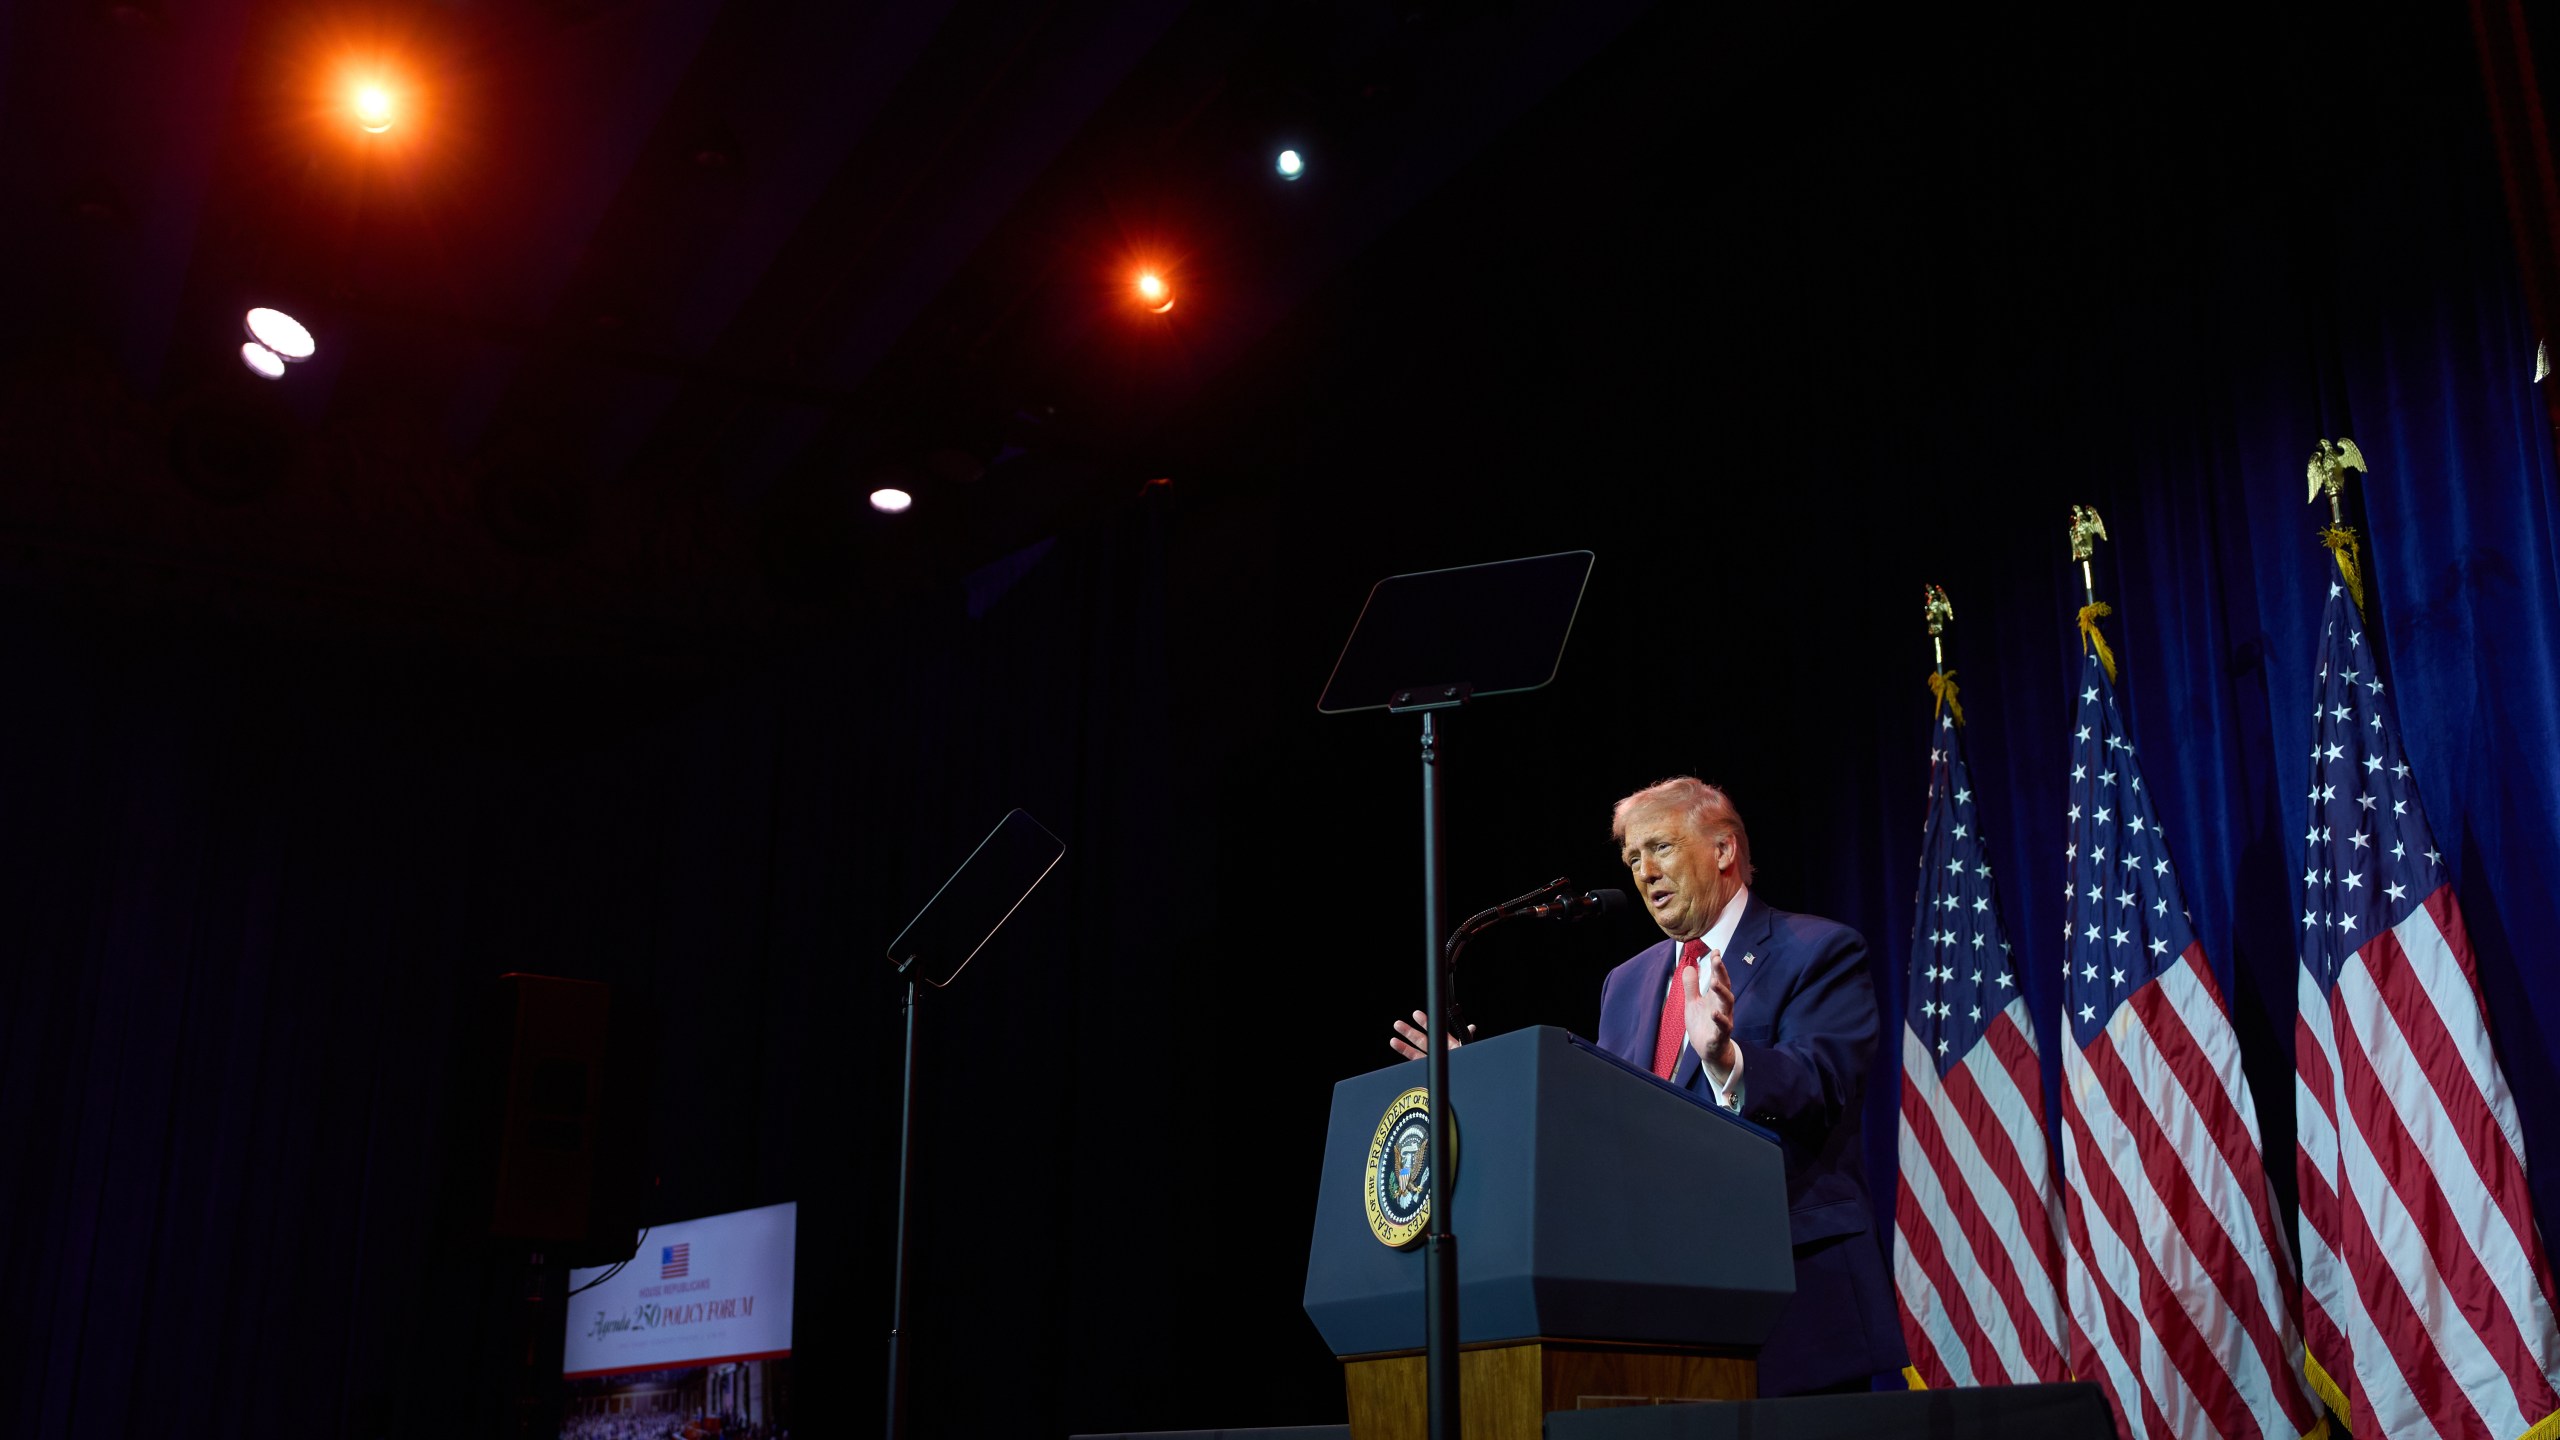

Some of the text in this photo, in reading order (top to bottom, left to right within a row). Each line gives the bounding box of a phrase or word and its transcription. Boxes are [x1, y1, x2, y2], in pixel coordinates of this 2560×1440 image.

[1413, 1094, 1421, 1105] OF
[1369, 1094, 1412, 1169] PRESIDENT
[1369, 1199, 1376, 1212] OF
[1373, 1209, 1394, 1240] SEAL
[663, 1279, 711, 1295] REPUBLICANS
[587, 1308, 631, 1342] Agenda
[631, 1303, 662, 1331] 250
[661, 1302, 706, 1328] POLICY
[707, 1296, 754, 1321] FORUM
